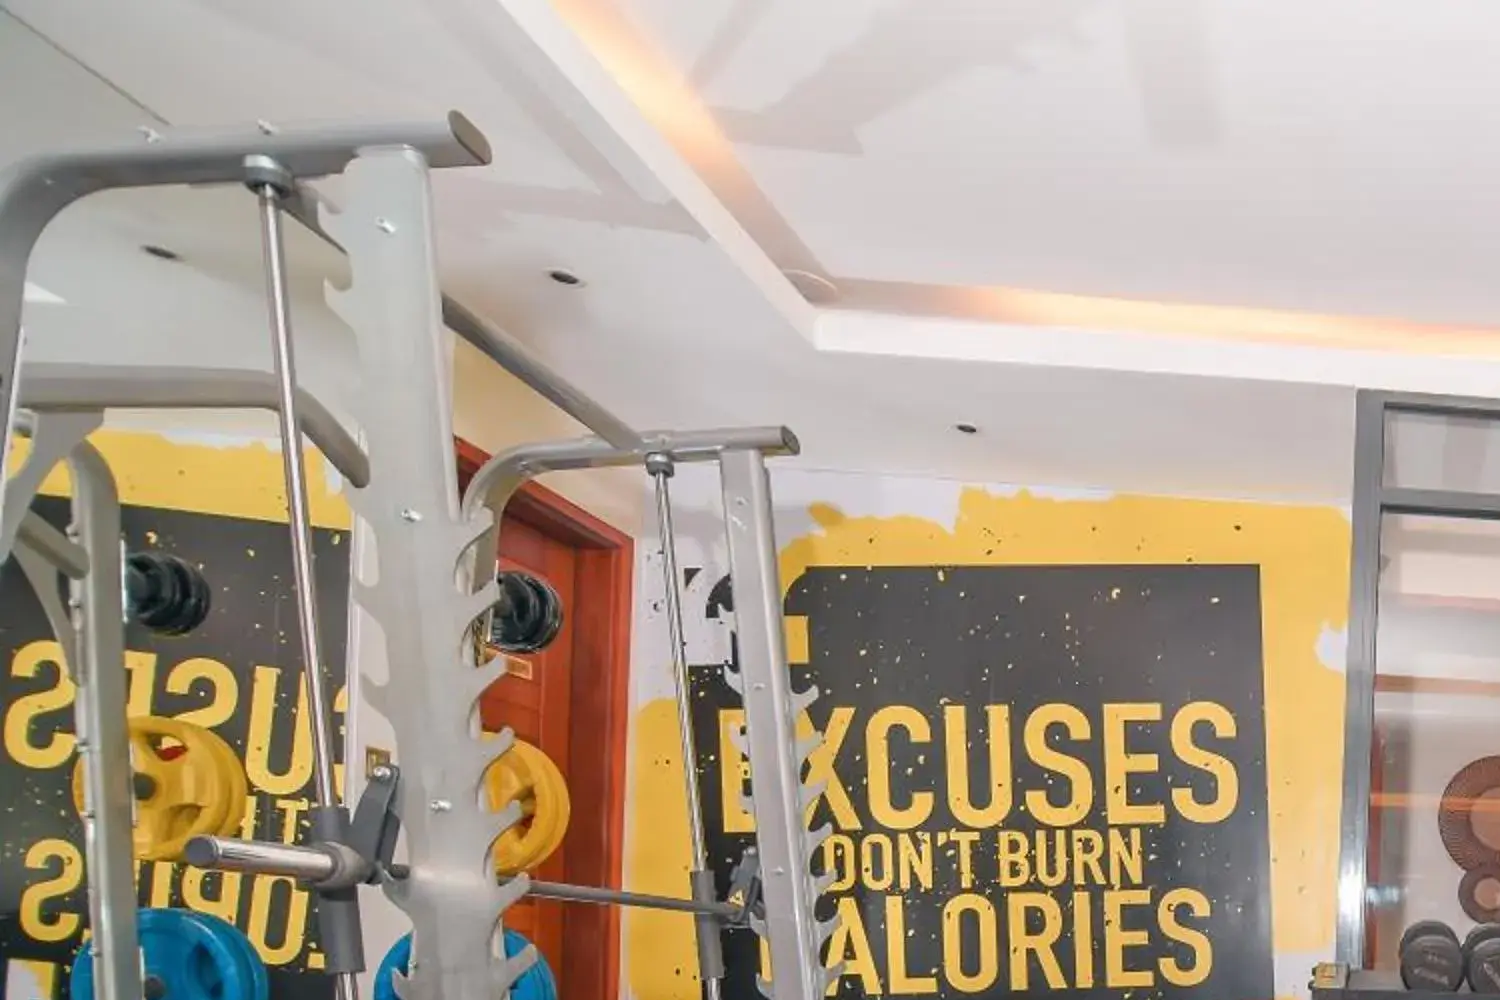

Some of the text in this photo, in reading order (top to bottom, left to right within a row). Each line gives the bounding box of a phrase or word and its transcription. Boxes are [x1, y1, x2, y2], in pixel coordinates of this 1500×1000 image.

[823, 828, 1144, 893] DON'T BURN
[758, 888, 1214, 997] ALORIES
